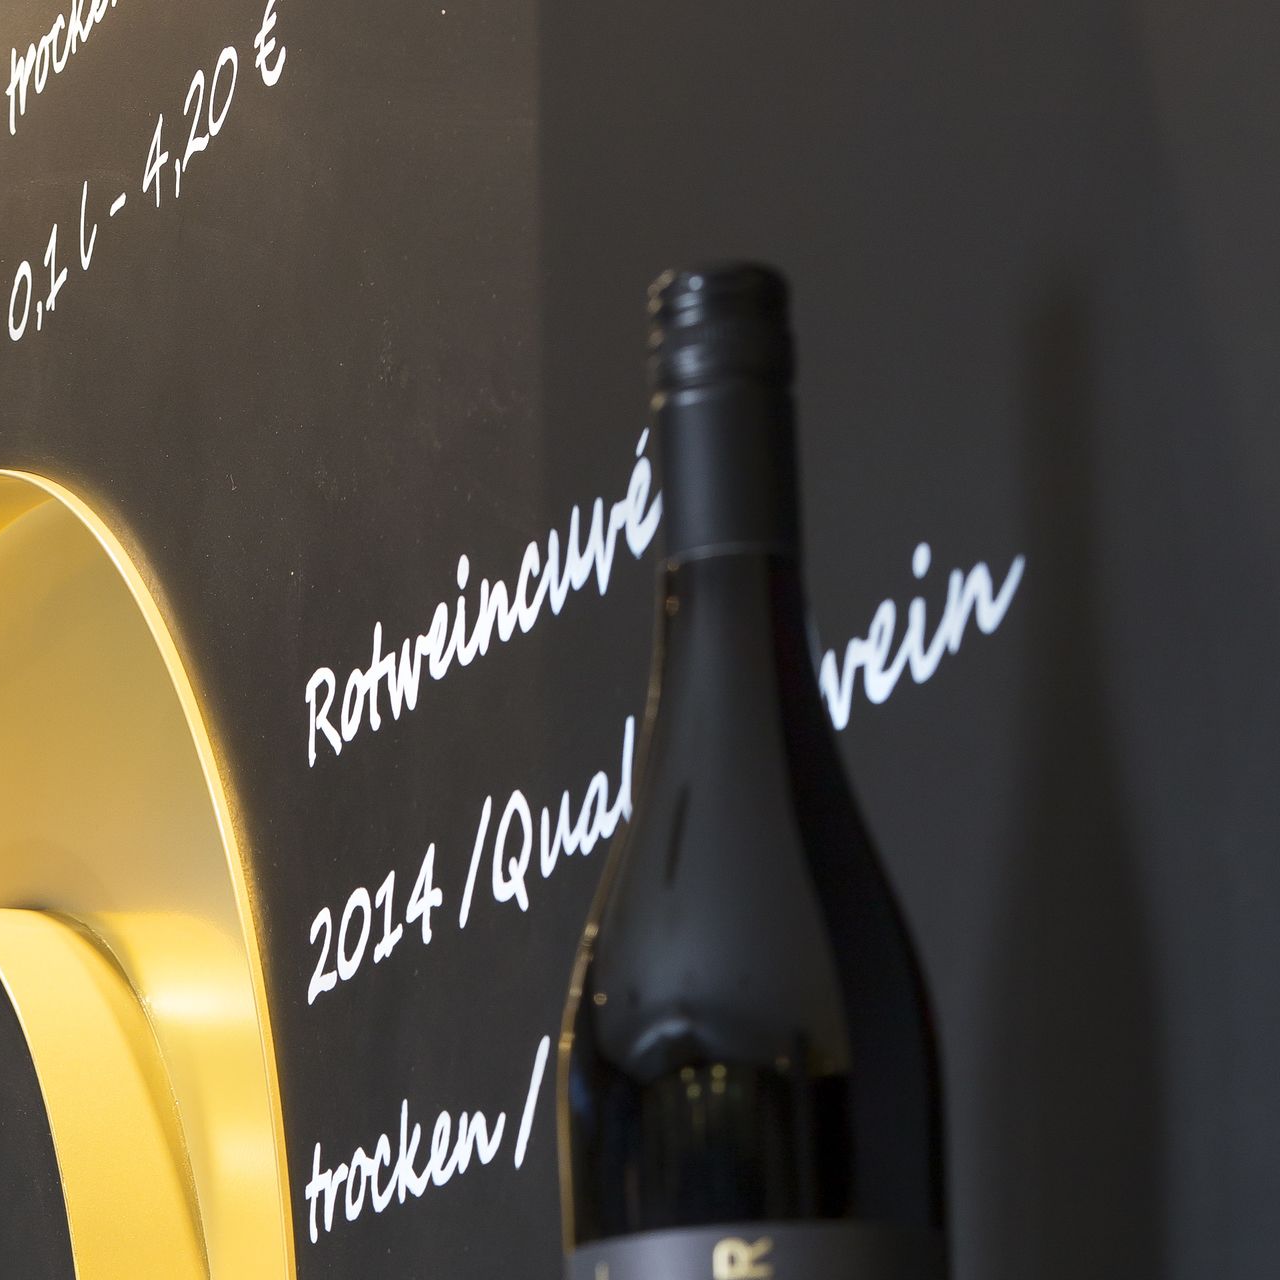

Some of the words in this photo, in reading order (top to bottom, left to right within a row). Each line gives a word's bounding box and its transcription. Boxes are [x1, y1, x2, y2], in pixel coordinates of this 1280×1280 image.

[5, 0, 118, 136] trock
[8, 223, 68, 342] 0,1
[142, 45, 239, 208] 4,20
[253, 0, 287, 87] €
[307, 842, 443, 1006] 2014
